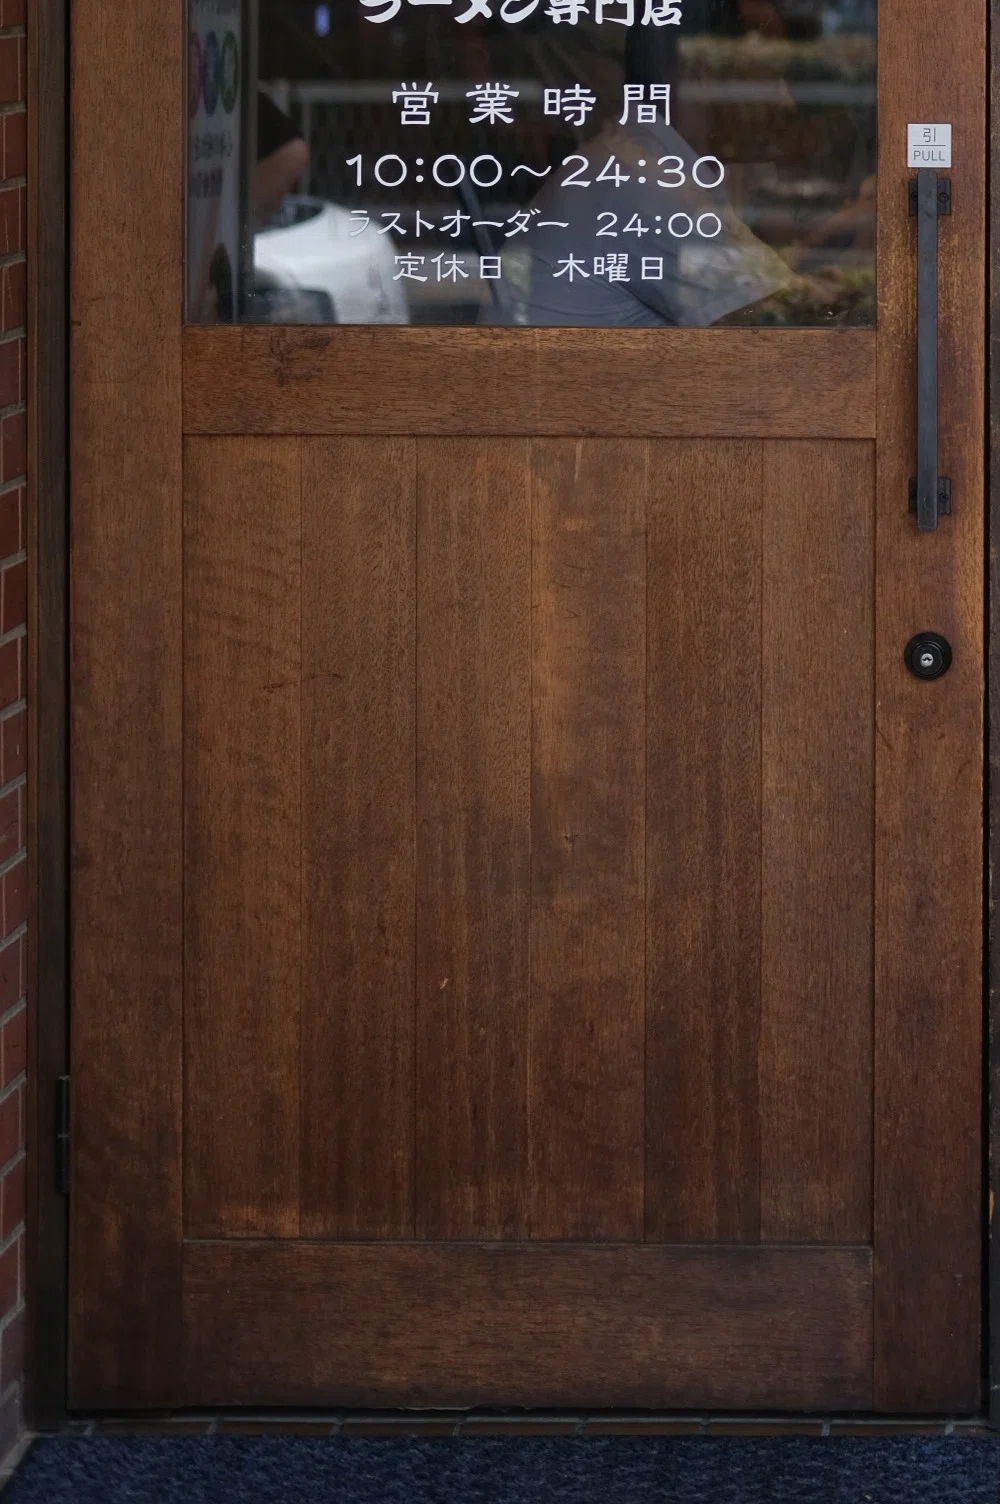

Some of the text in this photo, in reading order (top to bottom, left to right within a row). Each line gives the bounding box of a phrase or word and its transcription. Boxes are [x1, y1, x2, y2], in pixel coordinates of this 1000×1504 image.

[391, 81, 672, 126] 営業時間
[922, 127, 937, 143] 引
[913, 150, 946, 162] PULL
[347, 208, 722, 239] ラストオーダー 24:00
[392, 252, 664, 283] 定休日 木曜日
